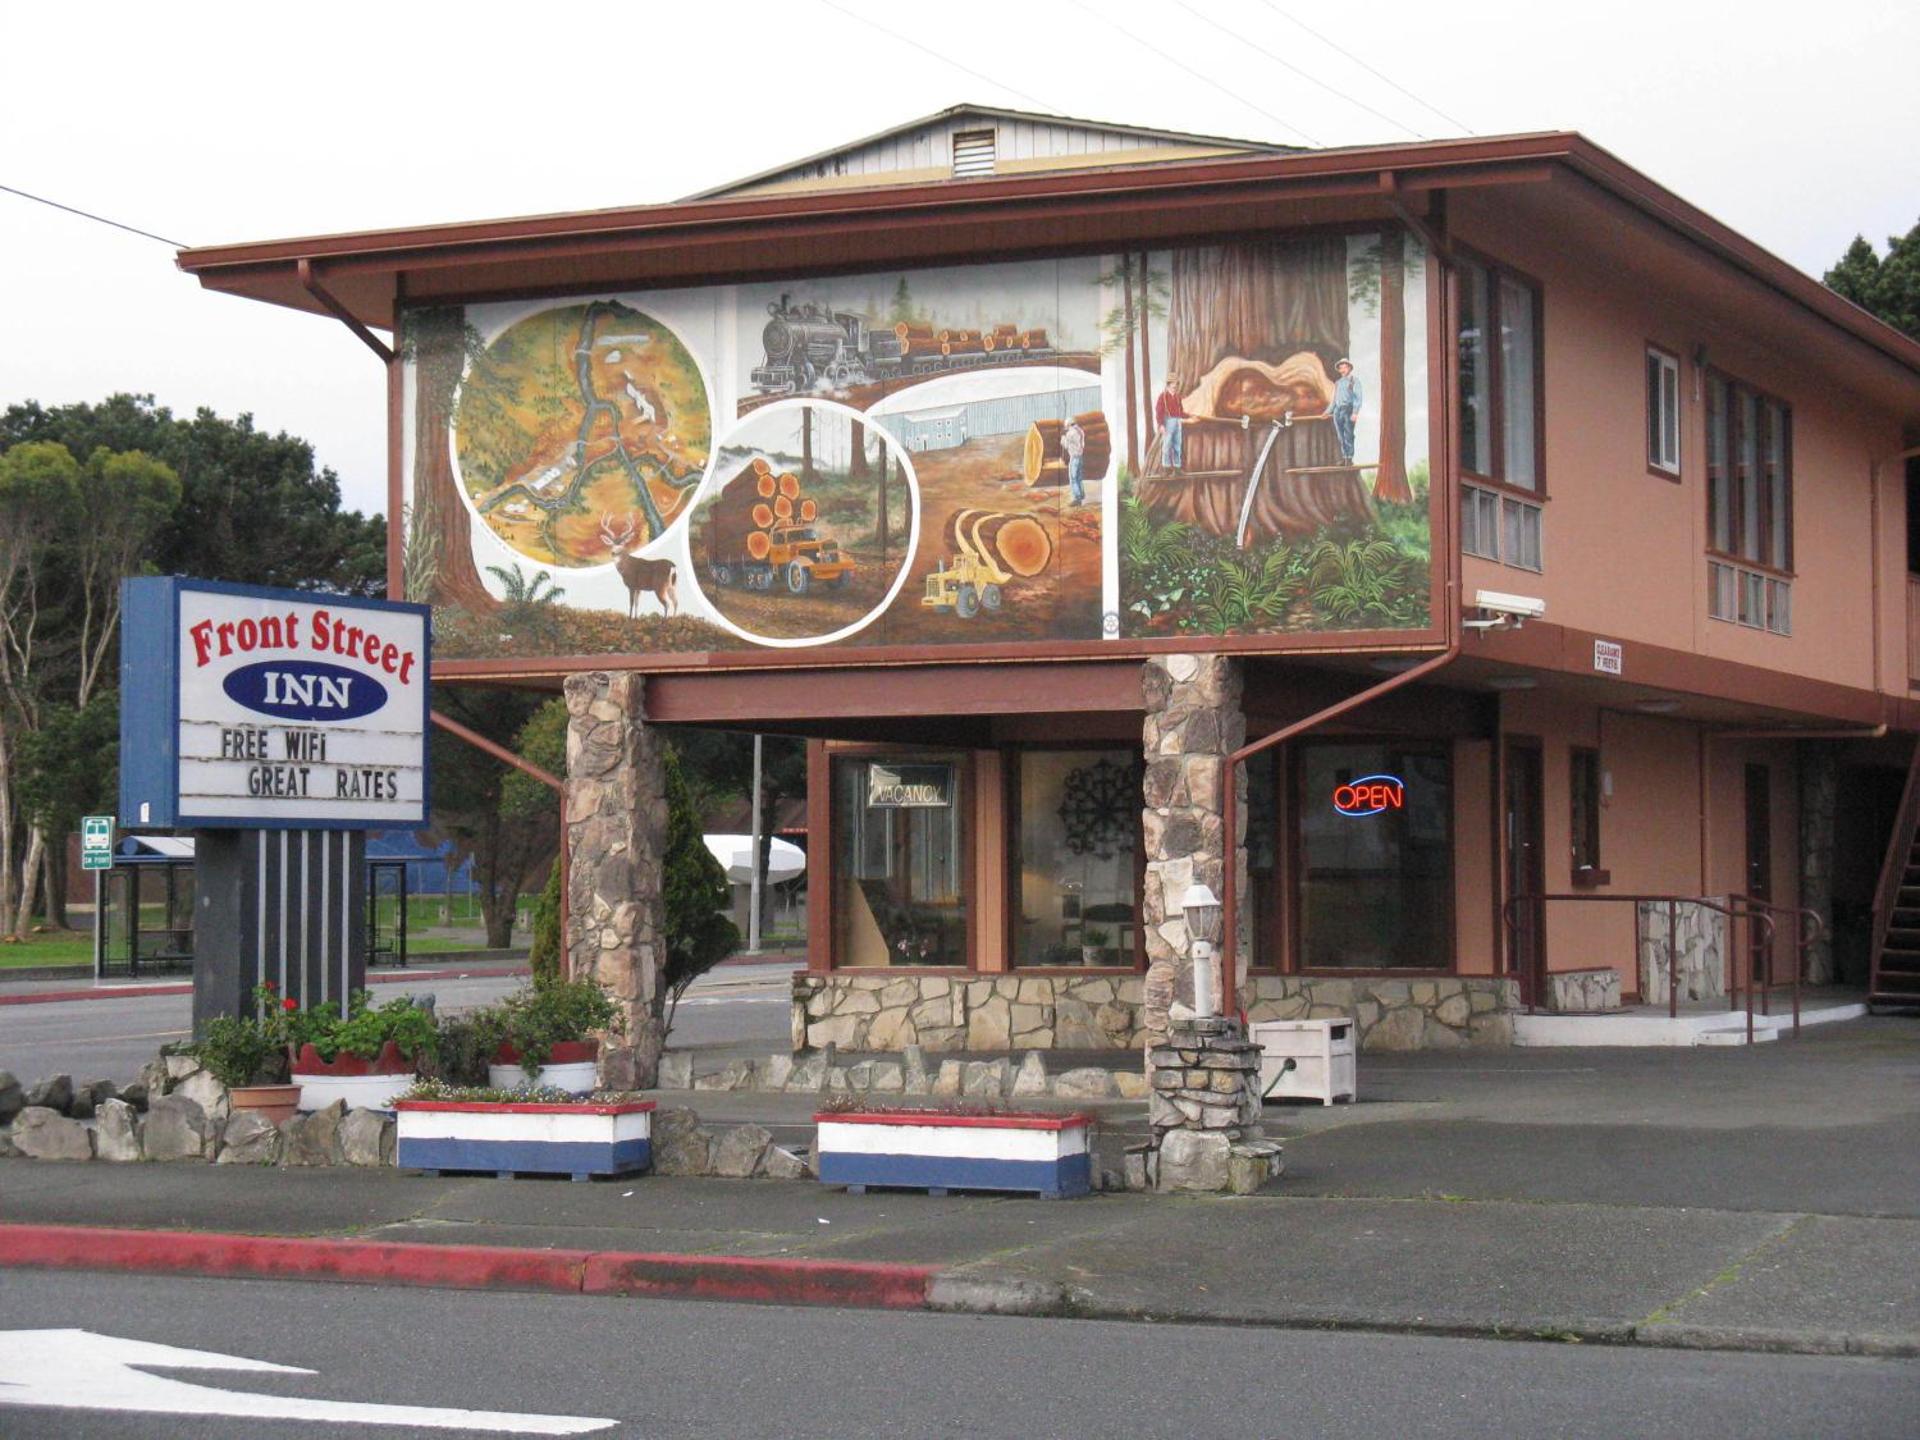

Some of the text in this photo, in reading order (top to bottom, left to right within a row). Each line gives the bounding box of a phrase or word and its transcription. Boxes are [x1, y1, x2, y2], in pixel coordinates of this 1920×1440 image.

[190, 610, 415, 685] Front Street
[263, 671, 353, 710] INN
[221, 728, 268, 760] FREE
[248, 765, 398, 800] GREAT RATES
[879, 784, 941, 803] VACANCY
[1333, 784, 1403, 809] OPEN
